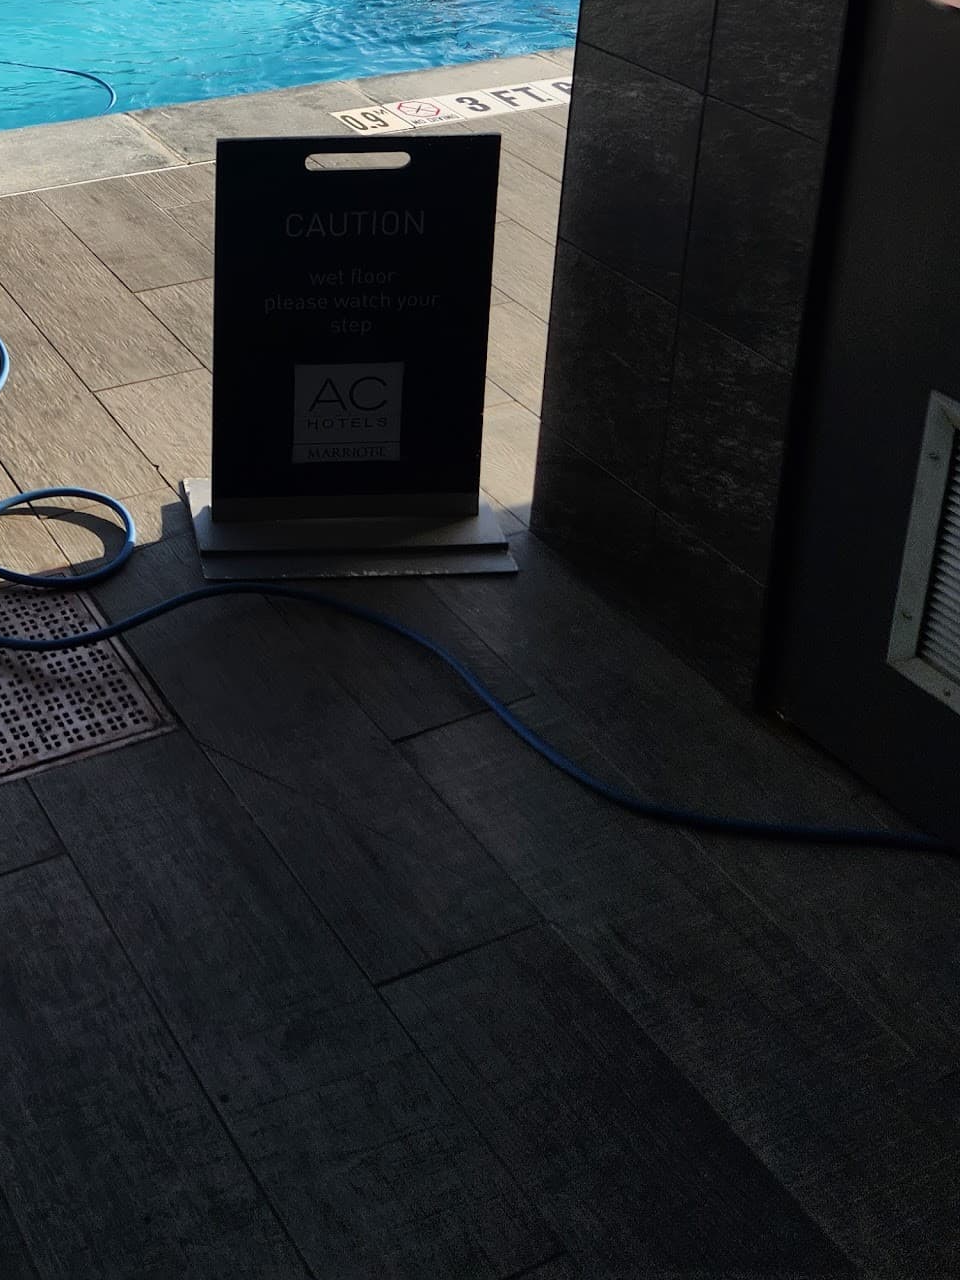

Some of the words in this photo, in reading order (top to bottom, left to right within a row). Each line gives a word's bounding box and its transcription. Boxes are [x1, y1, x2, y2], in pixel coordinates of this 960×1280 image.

[455, 96, 491, 112] 3
[489, 86, 553, 107] FT.
[285, 209, 425, 238] CAUTION
[309, 269, 344, 287] wet
[351, 267, 393, 286] floor
[264, 293, 328, 317] please
[334, 291, 392, 310] watch
[397, 294, 441, 311] your
[329, 316, 373, 336] step
[309, 376, 387, 411] AC
[307, 417, 387, 430] HOTELS
